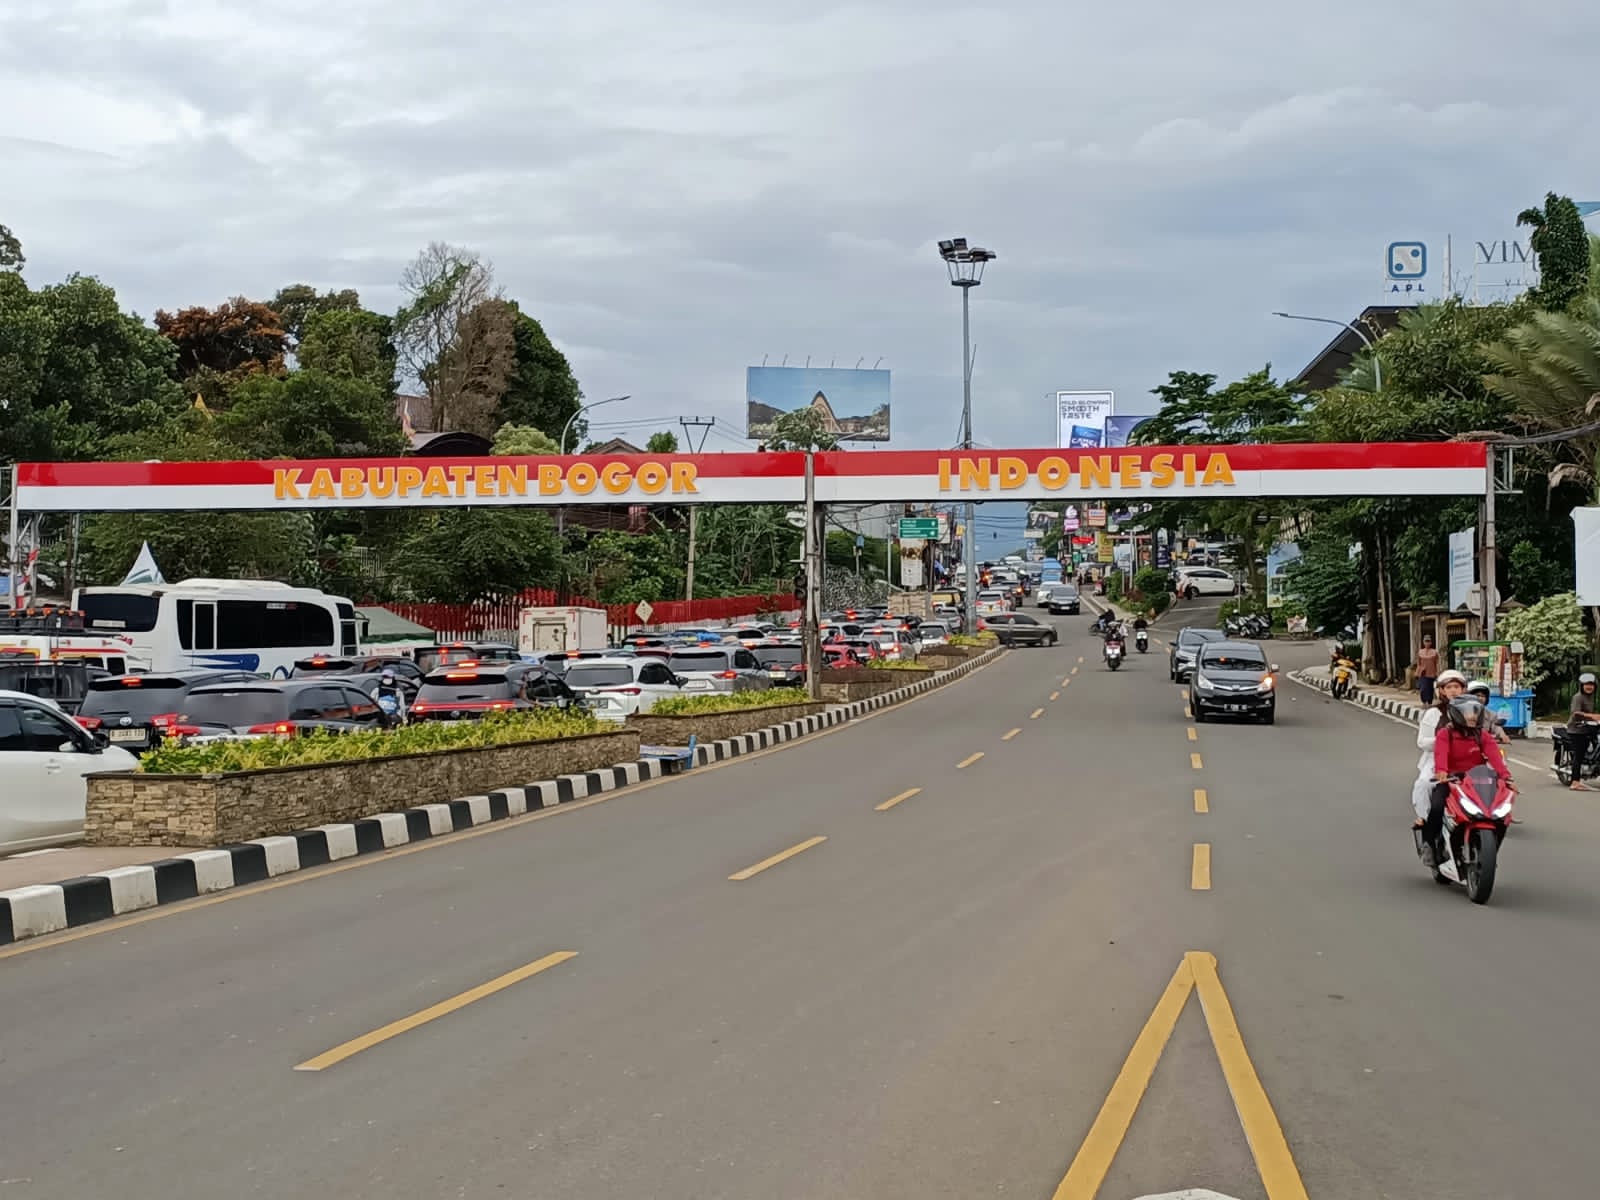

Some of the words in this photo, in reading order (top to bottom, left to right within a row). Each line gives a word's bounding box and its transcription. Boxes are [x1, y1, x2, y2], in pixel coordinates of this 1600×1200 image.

[1391, 284, 1425, 293] APL
[273, 464, 528, 499] KABUPATEN
[538, 461, 698, 495] BOGOR
[937, 453, 1236, 491] INDONESIA
